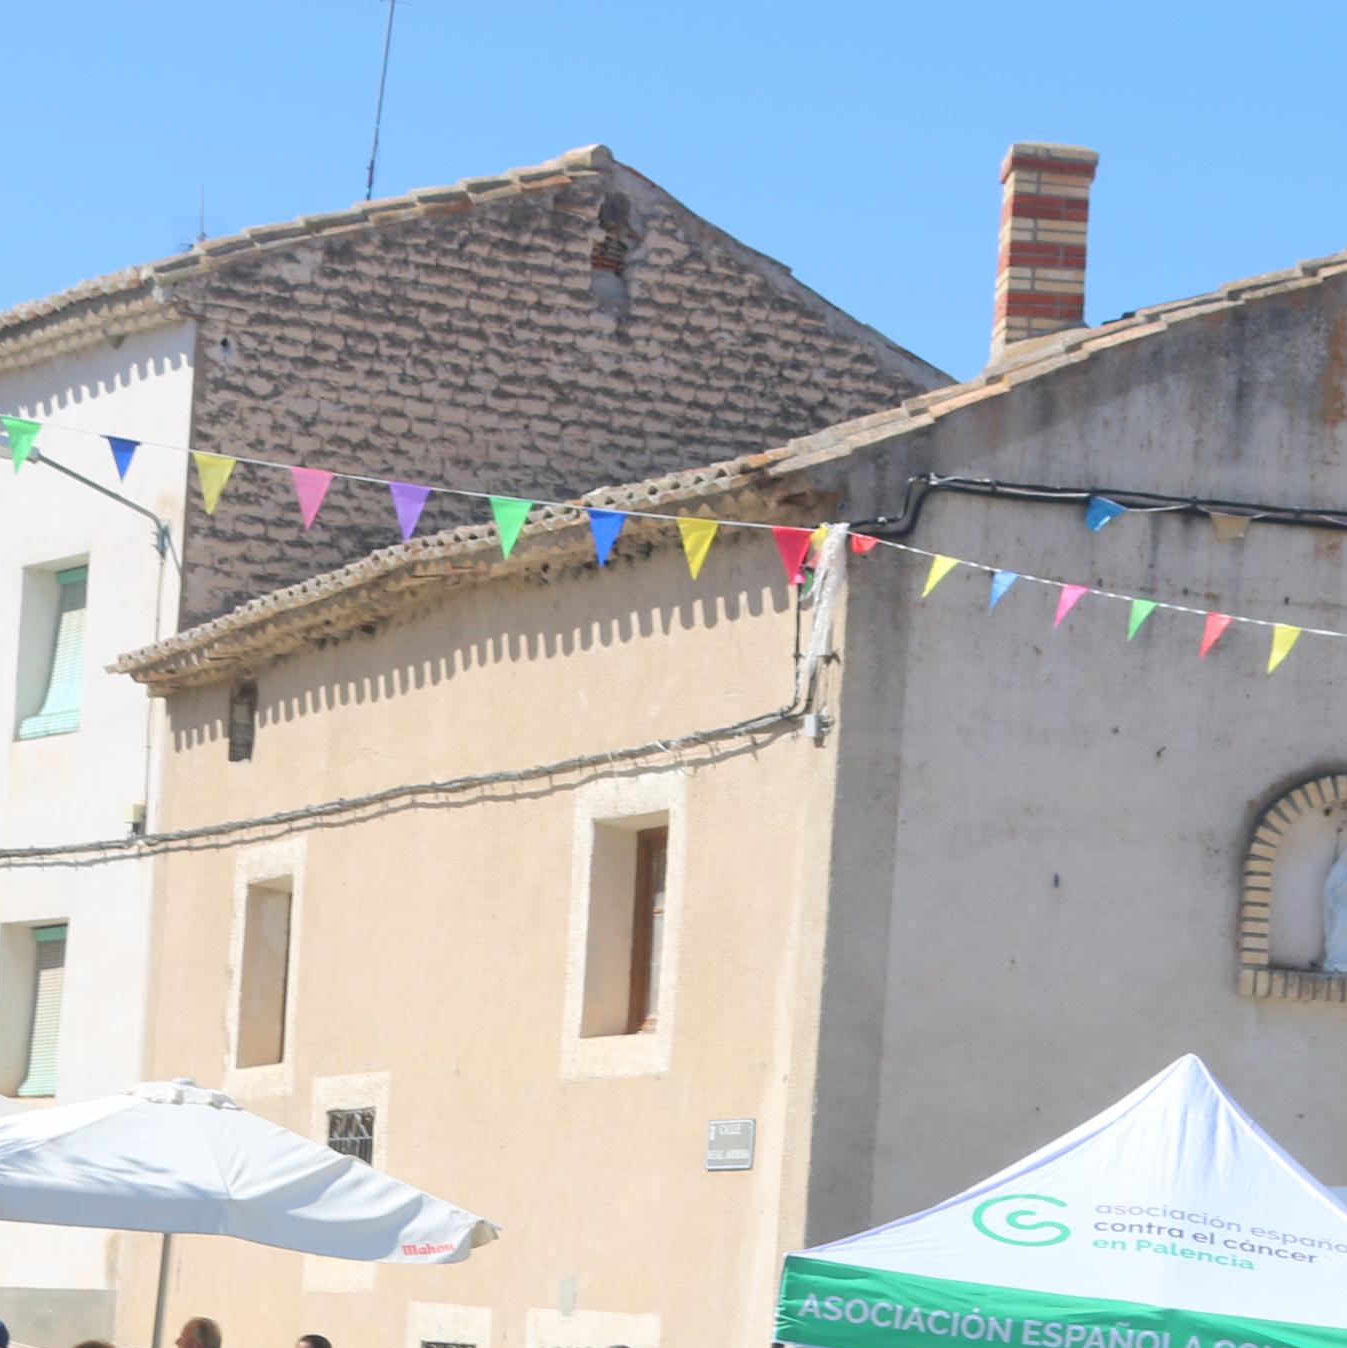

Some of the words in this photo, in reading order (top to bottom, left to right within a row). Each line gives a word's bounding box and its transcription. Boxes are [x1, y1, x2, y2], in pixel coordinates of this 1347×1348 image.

[1095, 1202, 1242, 1234] asociación
[1092, 1237, 1129, 1252] en
[1136, 1238, 1257, 1271] Palencia
[1093, 1218, 1184, 1240] contra
[1192, 1227, 1217, 1246] el
[1223, 1233, 1319, 1264] cáncer
[798, 1293, 1013, 1344] ASOCIACIÓN
